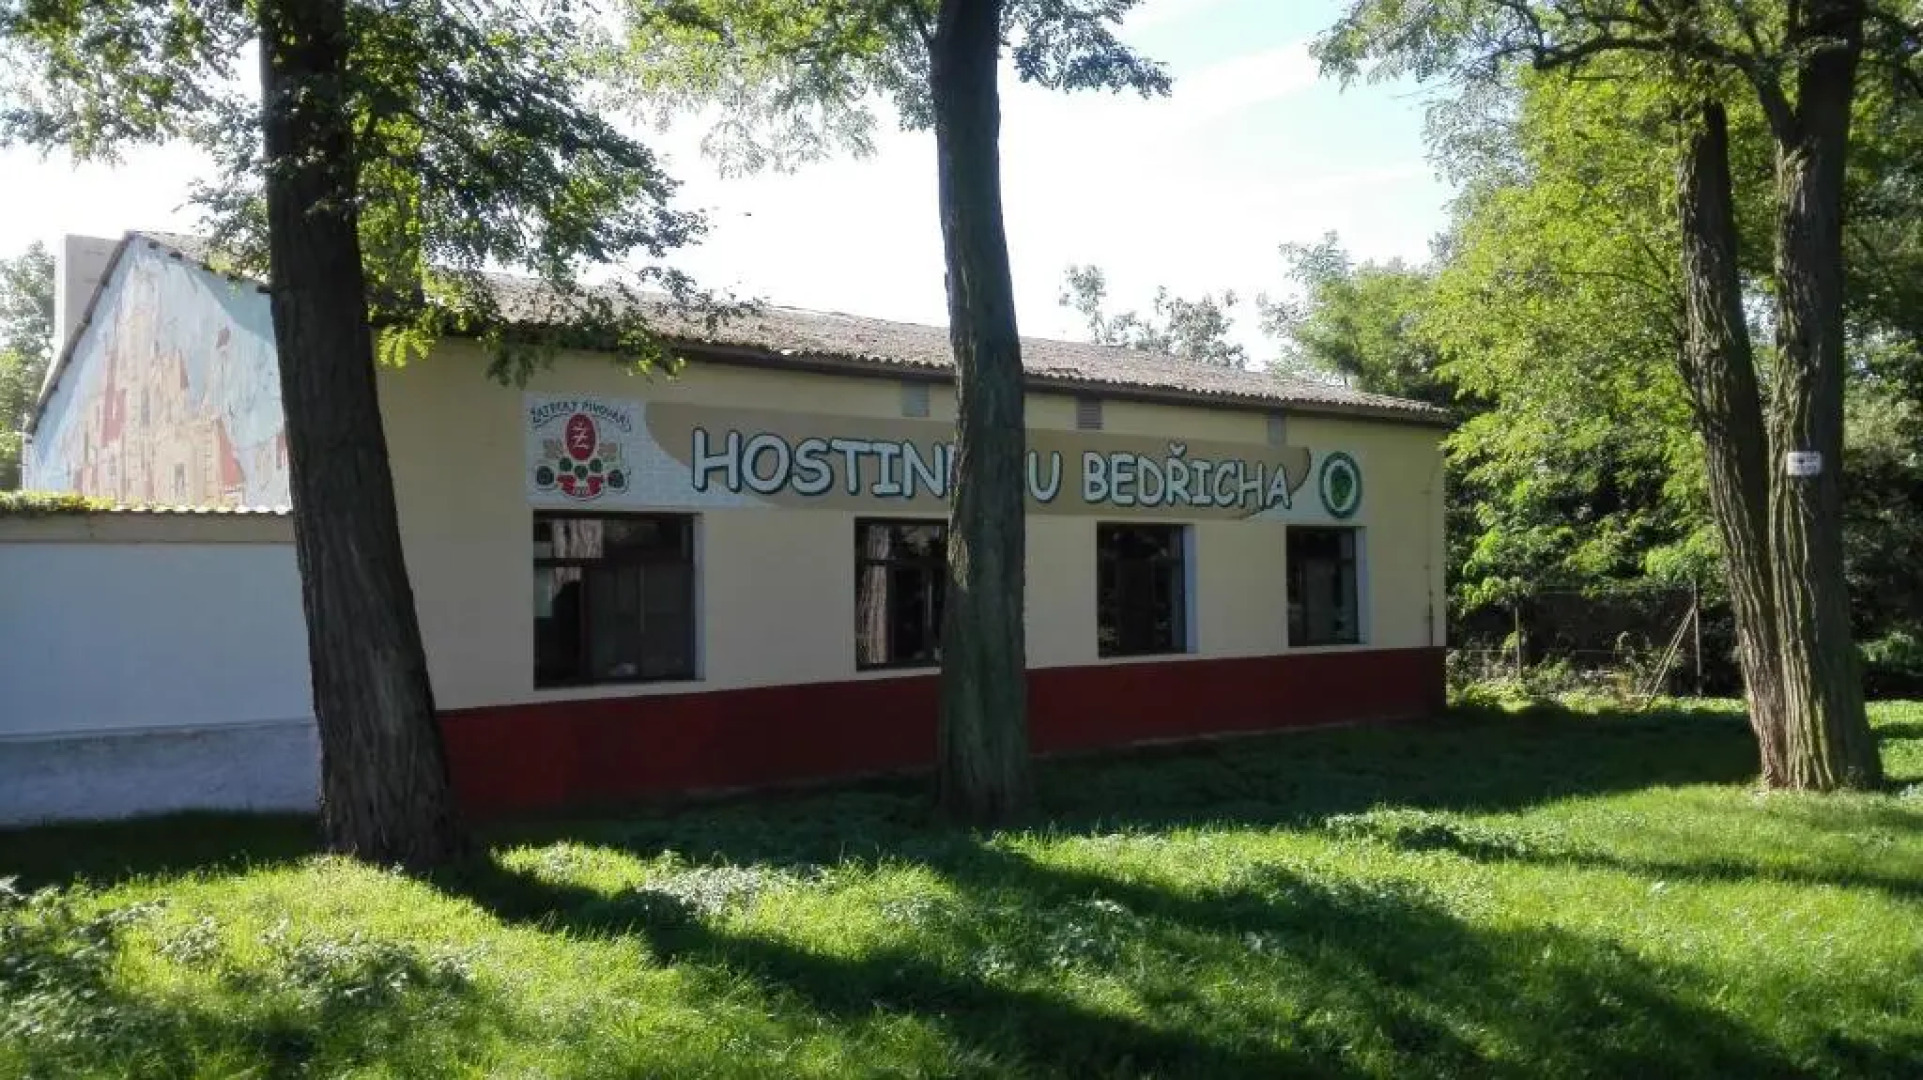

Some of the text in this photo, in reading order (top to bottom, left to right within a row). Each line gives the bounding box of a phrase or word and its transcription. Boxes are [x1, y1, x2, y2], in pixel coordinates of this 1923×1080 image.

[692, 427, 1292, 509] HOSTIN U BEDŘICHA
